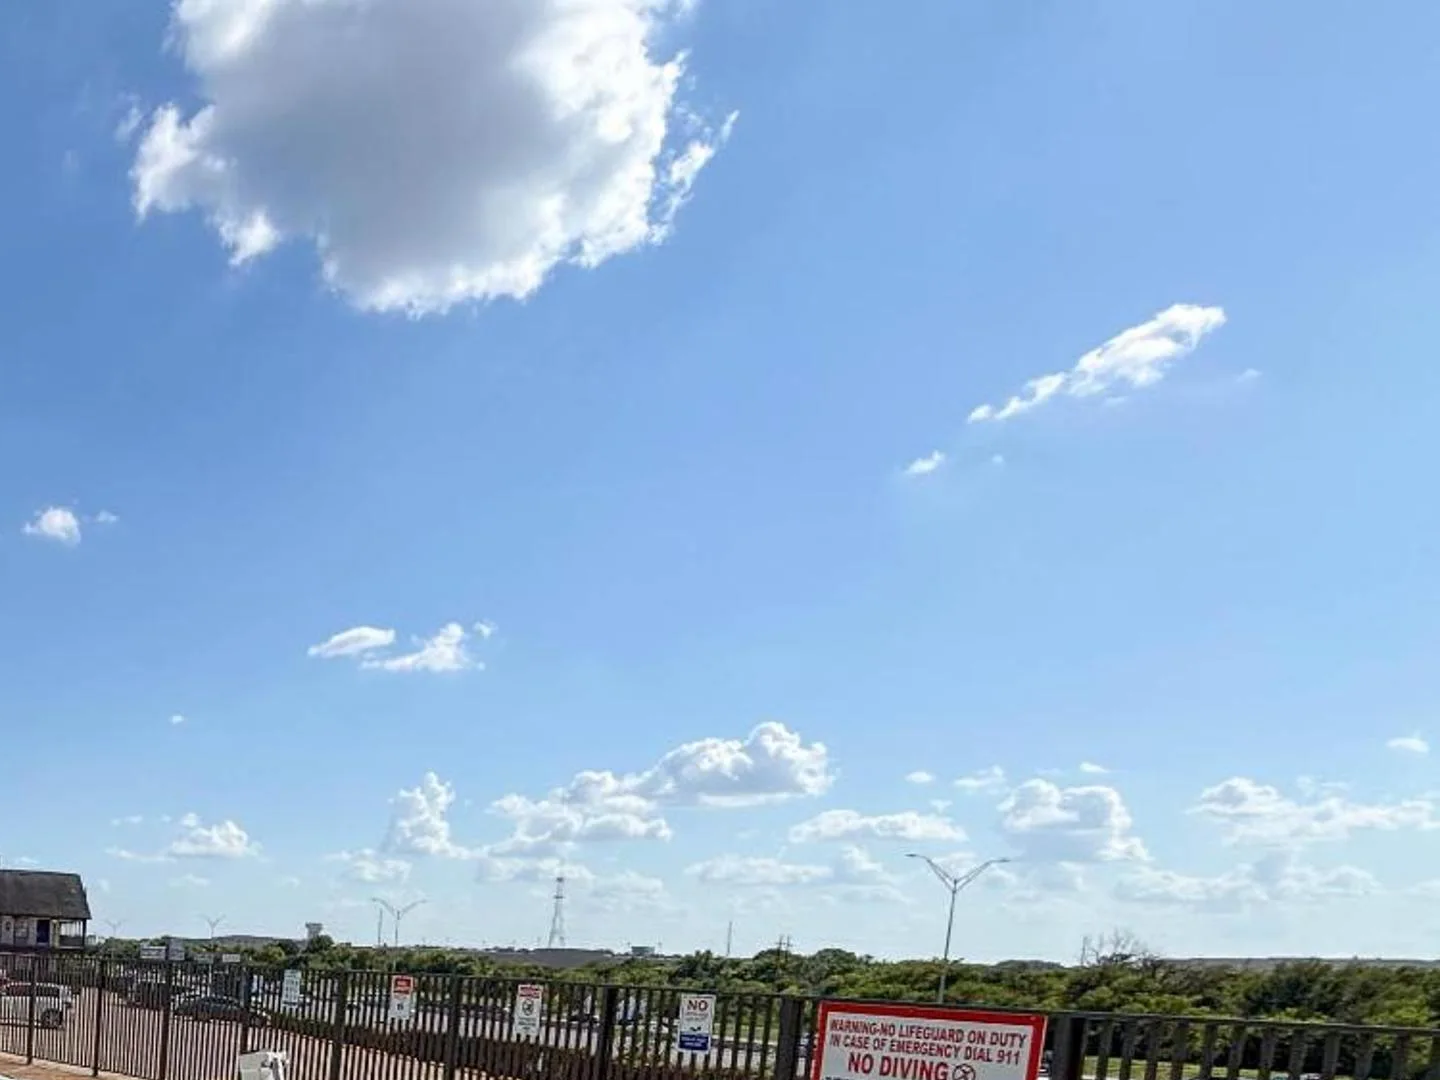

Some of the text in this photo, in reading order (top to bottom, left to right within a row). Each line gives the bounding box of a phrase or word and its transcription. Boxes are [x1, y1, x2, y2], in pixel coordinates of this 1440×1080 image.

[687, 1000, 708, 1011] NO
[898, 1024, 964, 1043] LIFEGUARD
[967, 1030, 986, 1045] ON
[990, 1031, 1028, 1048] DUTY
[830, 1033, 1020, 1065] IN CASE OF EMERGENCY DIAL 911
[847, 1052, 874, 1075] NO
